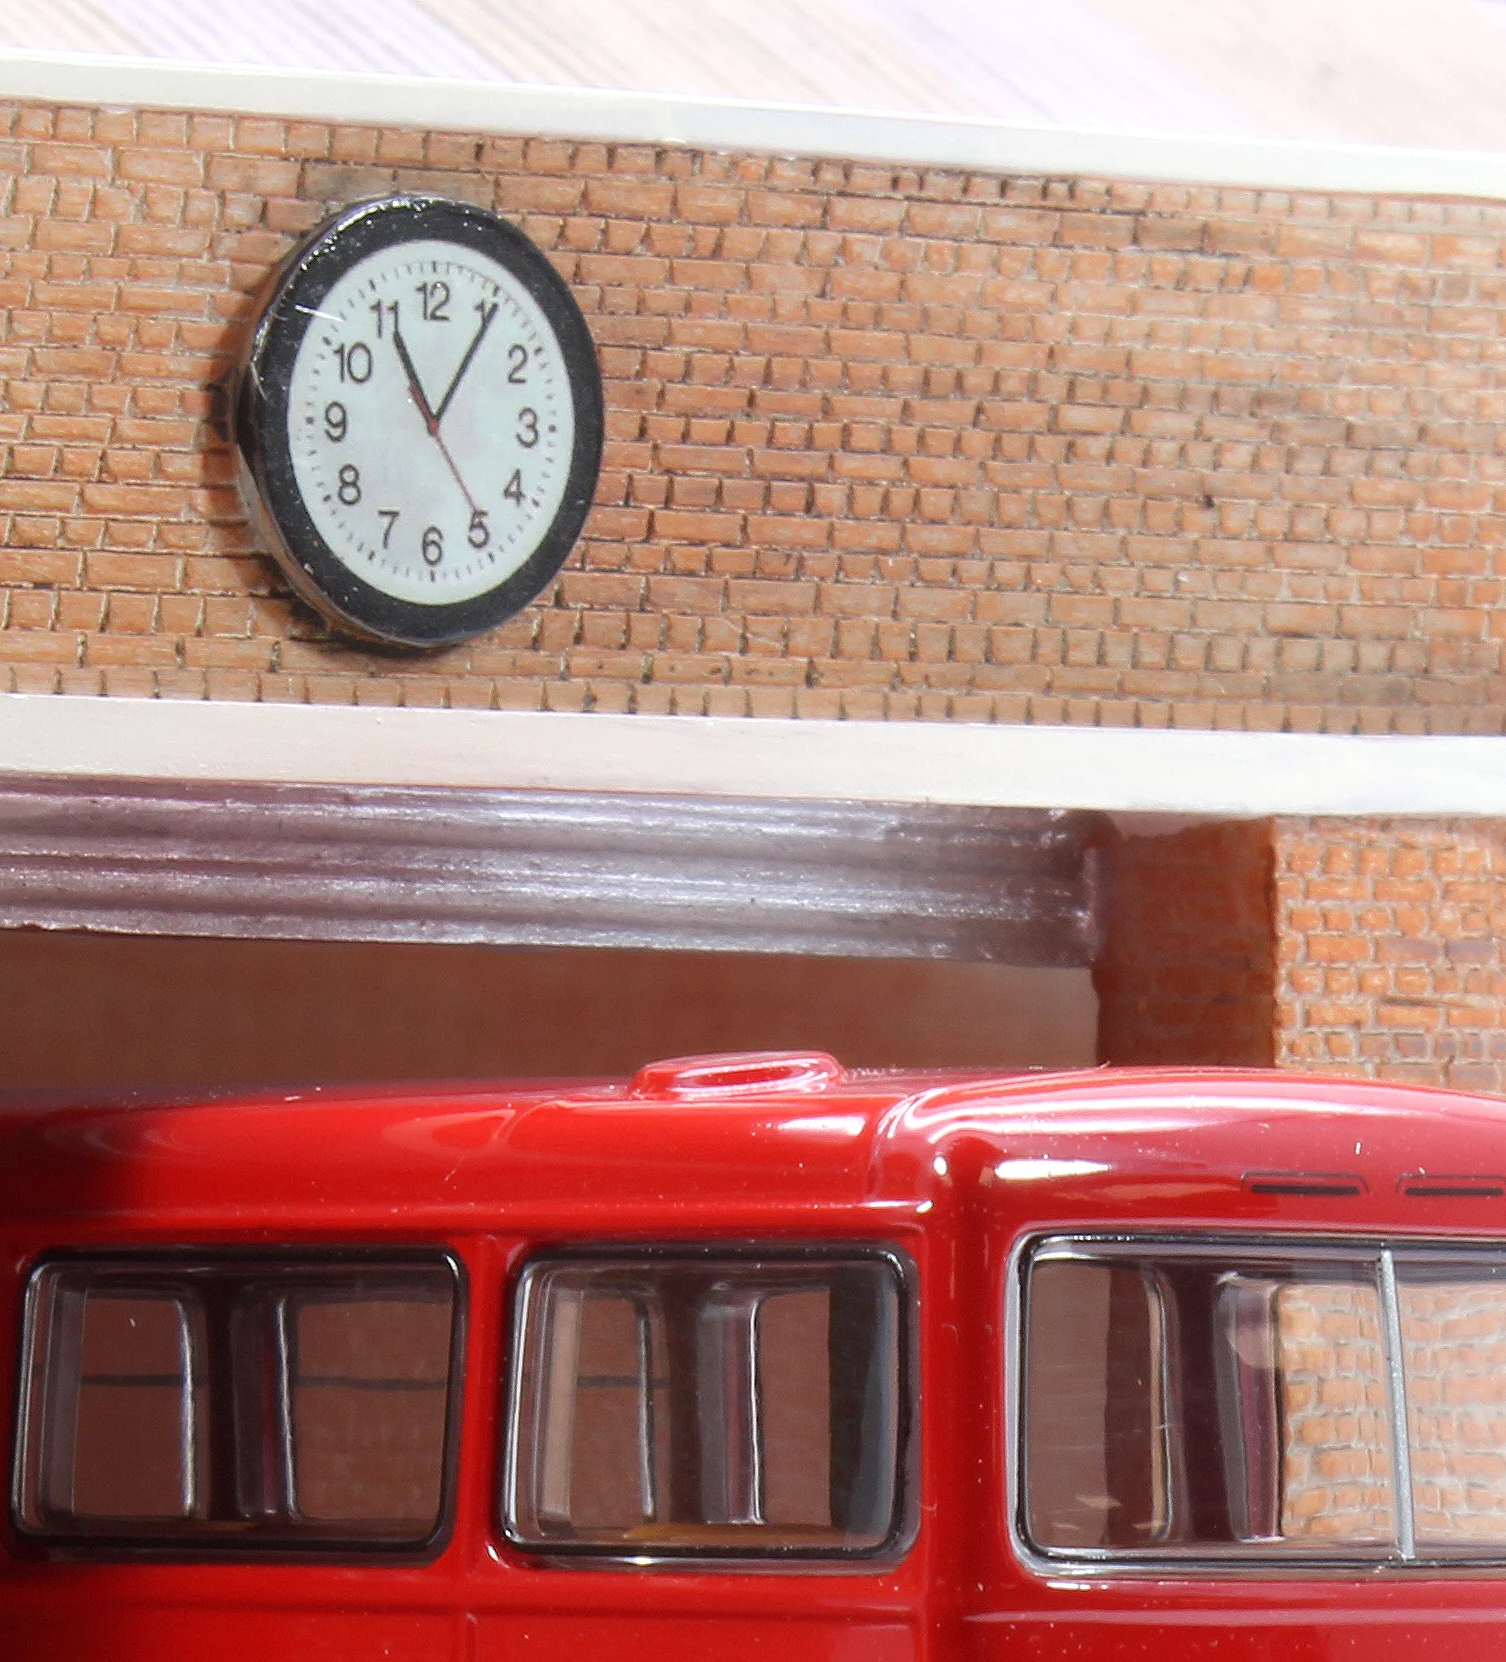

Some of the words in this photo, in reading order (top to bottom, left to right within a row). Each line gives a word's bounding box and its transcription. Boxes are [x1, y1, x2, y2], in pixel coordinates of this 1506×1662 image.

[370, 299, 399, 339] 11
[414, 281, 450, 321] 12
[333, 342, 373, 384] 10
[507, 344, 529, 384] 2
[324, 401, 347, 442] 9
[516, 407, 540, 448] 3
[337, 463, 362, 505] 8
[503, 468, 526, 507] 4
[378, 510, 400, 549] 7
[422, 524, 443, 566] 6
[467, 509, 490, 549] 5
